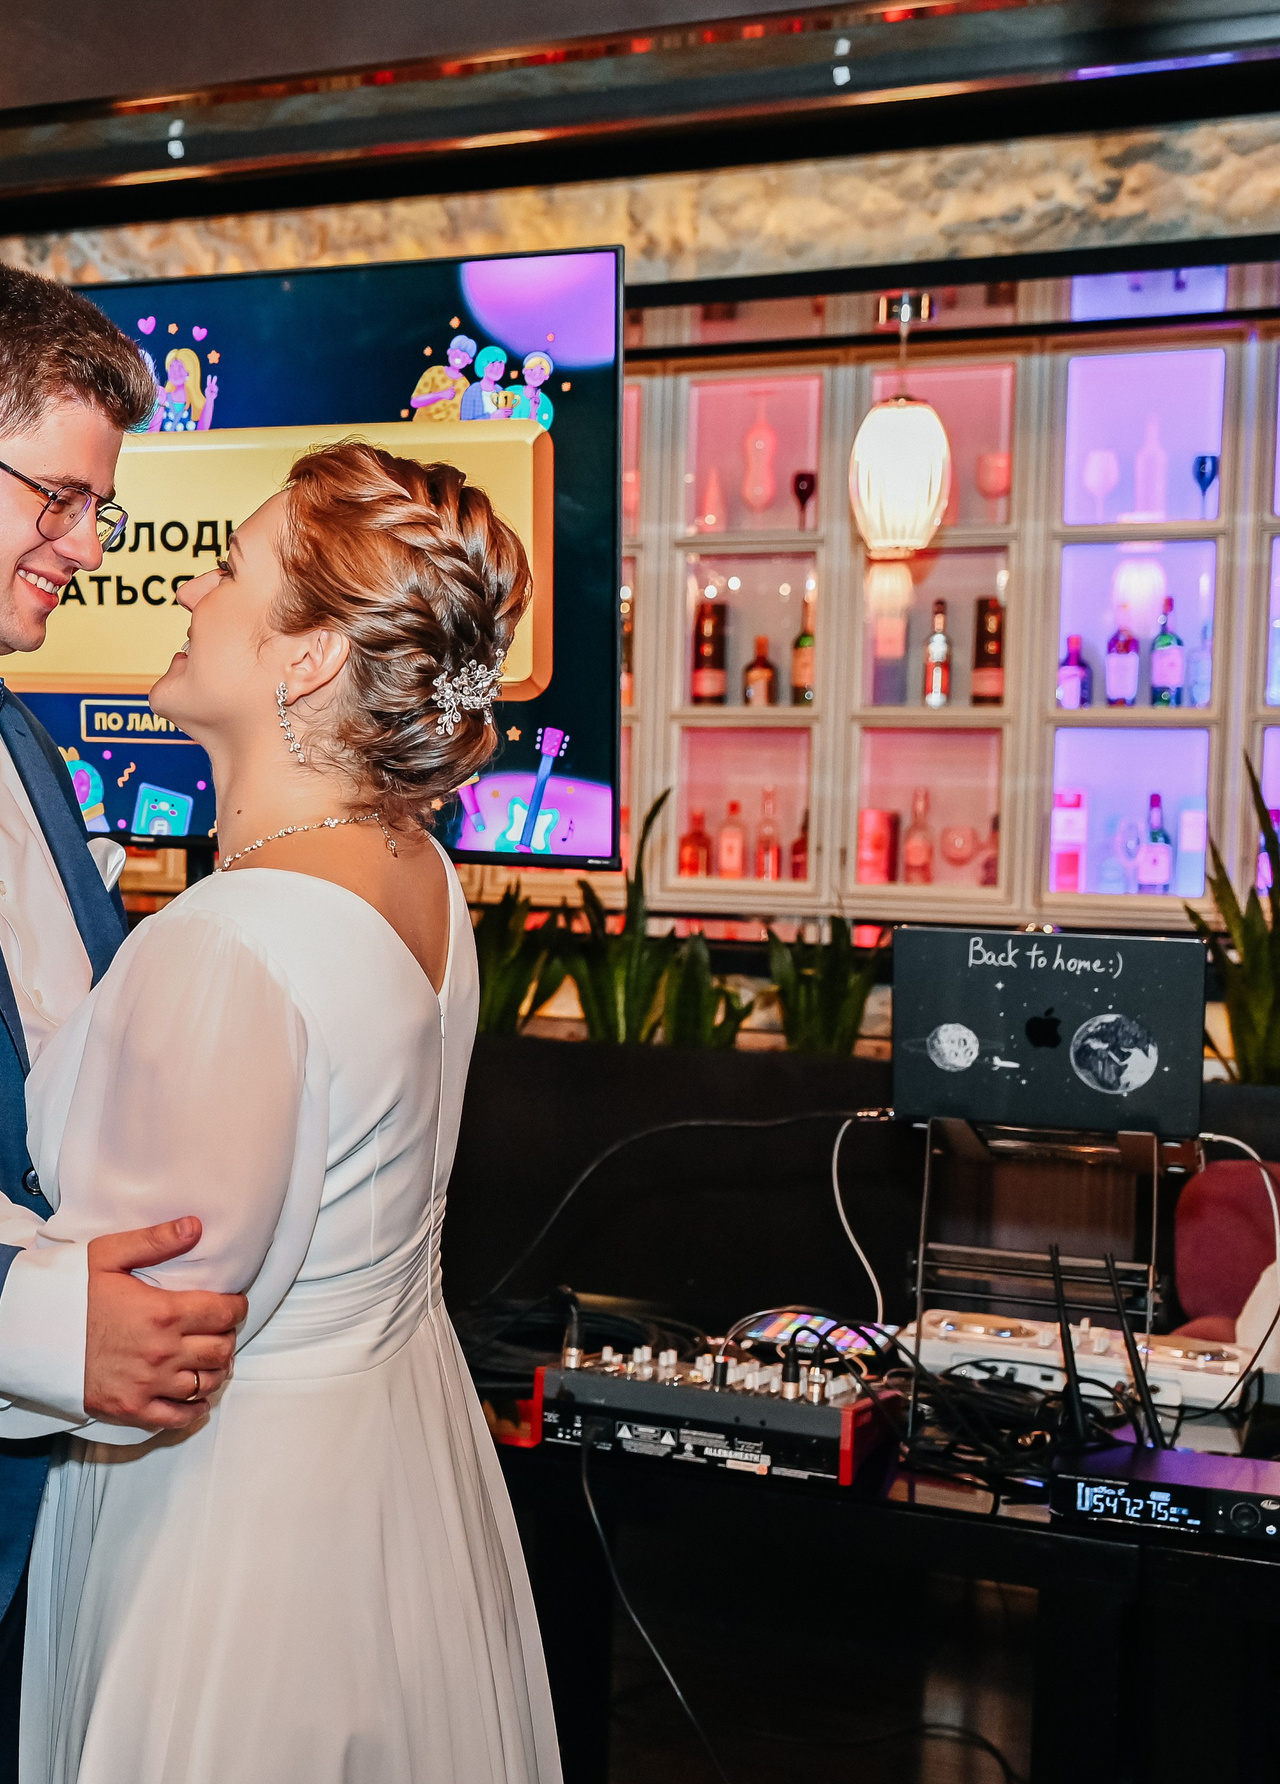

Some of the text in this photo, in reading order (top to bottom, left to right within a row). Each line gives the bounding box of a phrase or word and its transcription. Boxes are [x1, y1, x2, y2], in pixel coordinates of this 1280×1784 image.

[94, 711, 182, 732] ПО ЛАЙ
[968, 936, 1020, 968] Back
[1025, 942, 1048, 970] to
